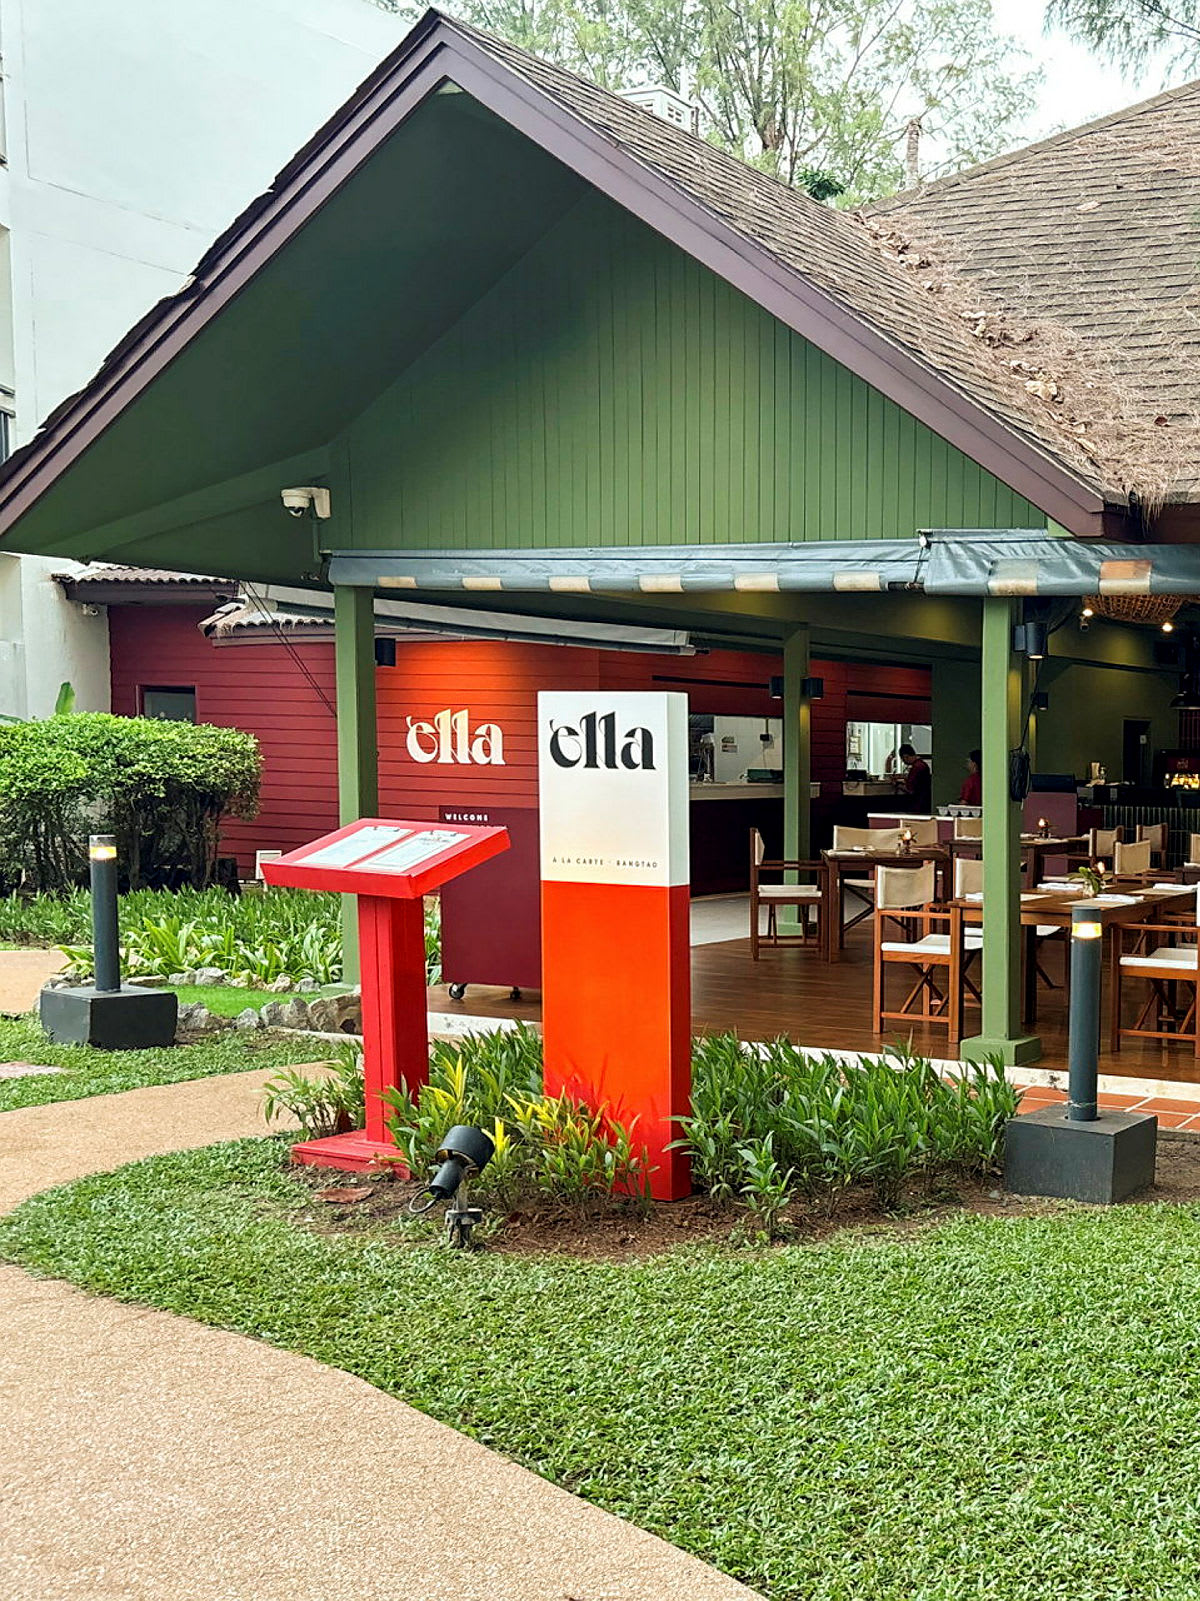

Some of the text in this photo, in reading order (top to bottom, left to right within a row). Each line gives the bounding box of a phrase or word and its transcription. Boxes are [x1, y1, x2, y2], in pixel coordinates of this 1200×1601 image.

[406, 708, 505, 765] ella
[549, 711, 656, 770] ella
[445, 813, 489, 822] WELCOME
[576, 857, 604, 866] CARTE
